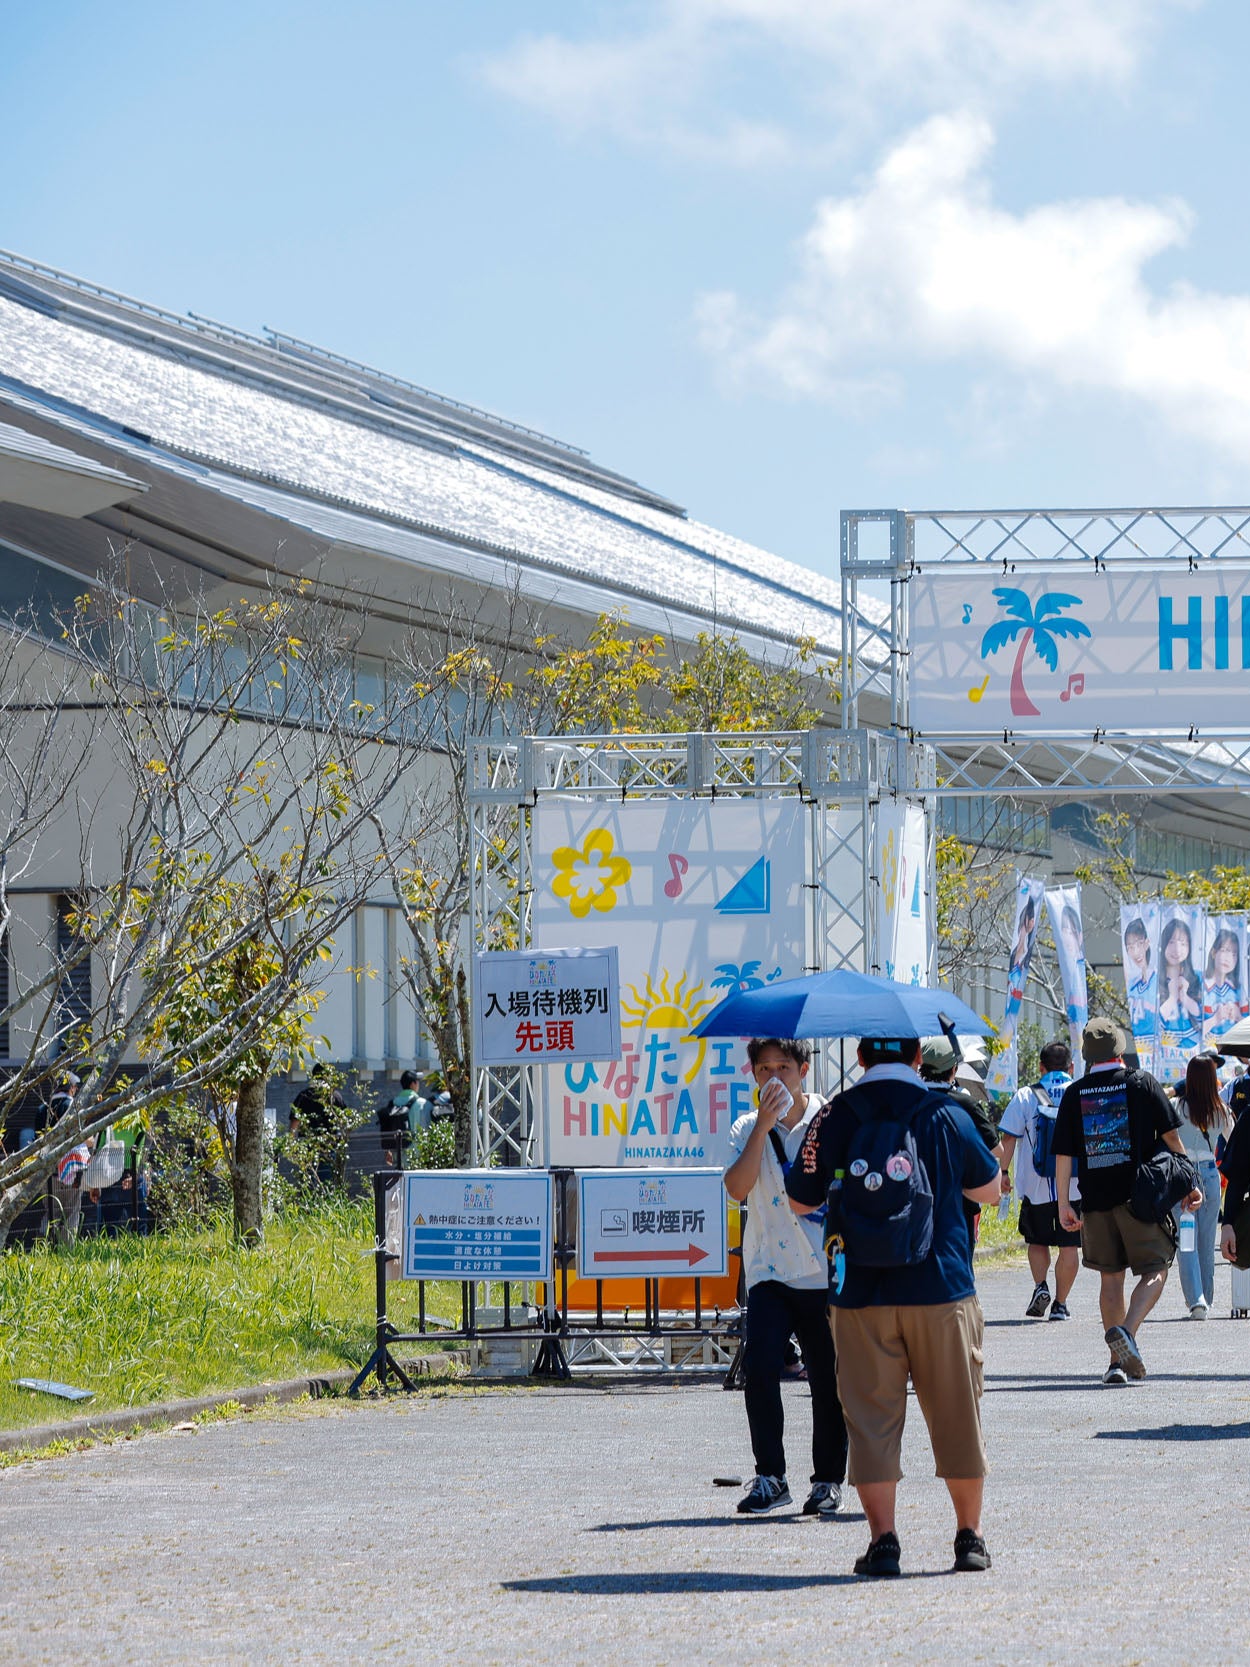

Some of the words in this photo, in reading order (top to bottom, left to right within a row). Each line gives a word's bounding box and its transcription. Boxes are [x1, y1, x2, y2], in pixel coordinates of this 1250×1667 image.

[484, 988, 608, 1018] 入場待機列
[515, 1020, 575, 1053] 先頭
[563, 1089, 699, 1136] HINATA
[709, 1082, 760, 1134] FE
[625, 1146, 705, 1159] HINATAZAKA46
[428, 1214, 540, 1226] 熱中症にご注意ください！
[632, 1209, 706, 1234] 喫煙所
